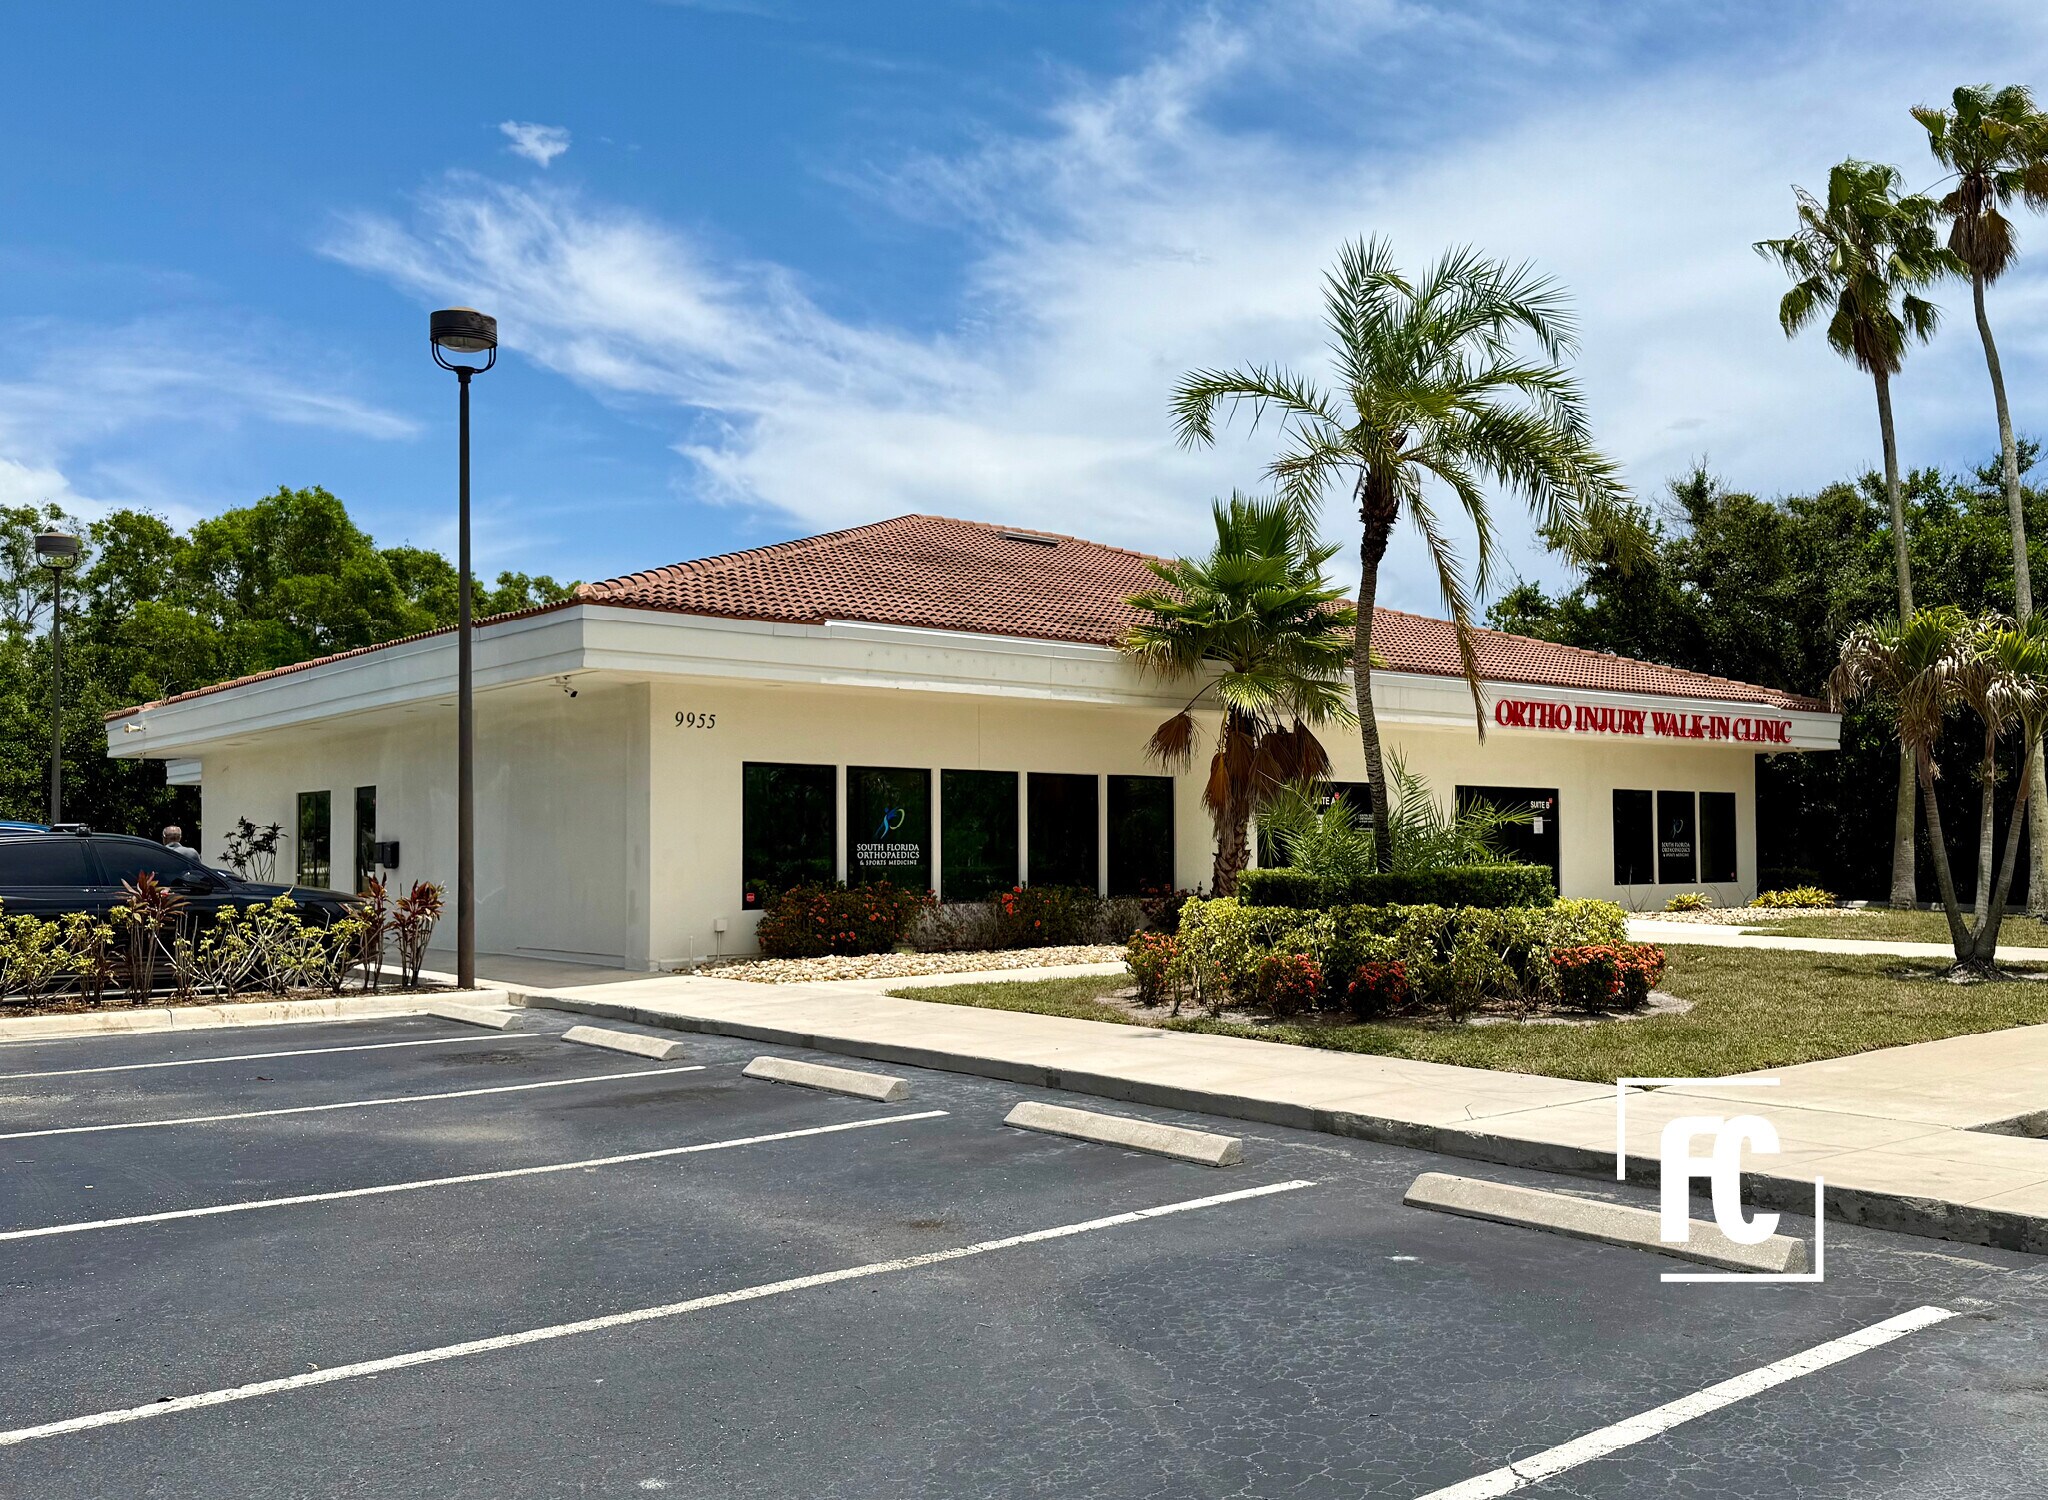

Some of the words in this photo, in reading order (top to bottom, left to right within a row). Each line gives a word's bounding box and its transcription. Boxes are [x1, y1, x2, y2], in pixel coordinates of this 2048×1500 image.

[675, 711, 716, 729] 9955
[1495, 699, 1572, 730] ORTHO
[1575, 705, 1647, 734] INJURY
[1651, 711, 1730, 740] WALK-IN
[1733, 717, 1792, 743] CLINIC
[1530, 800, 1545, 809] SUITE
[856, 843, 884, 851] SOUTH
[886, 843, 920, 851] FLORIDA
[857, 851, 920, 859] ORTHOPAEDICS
